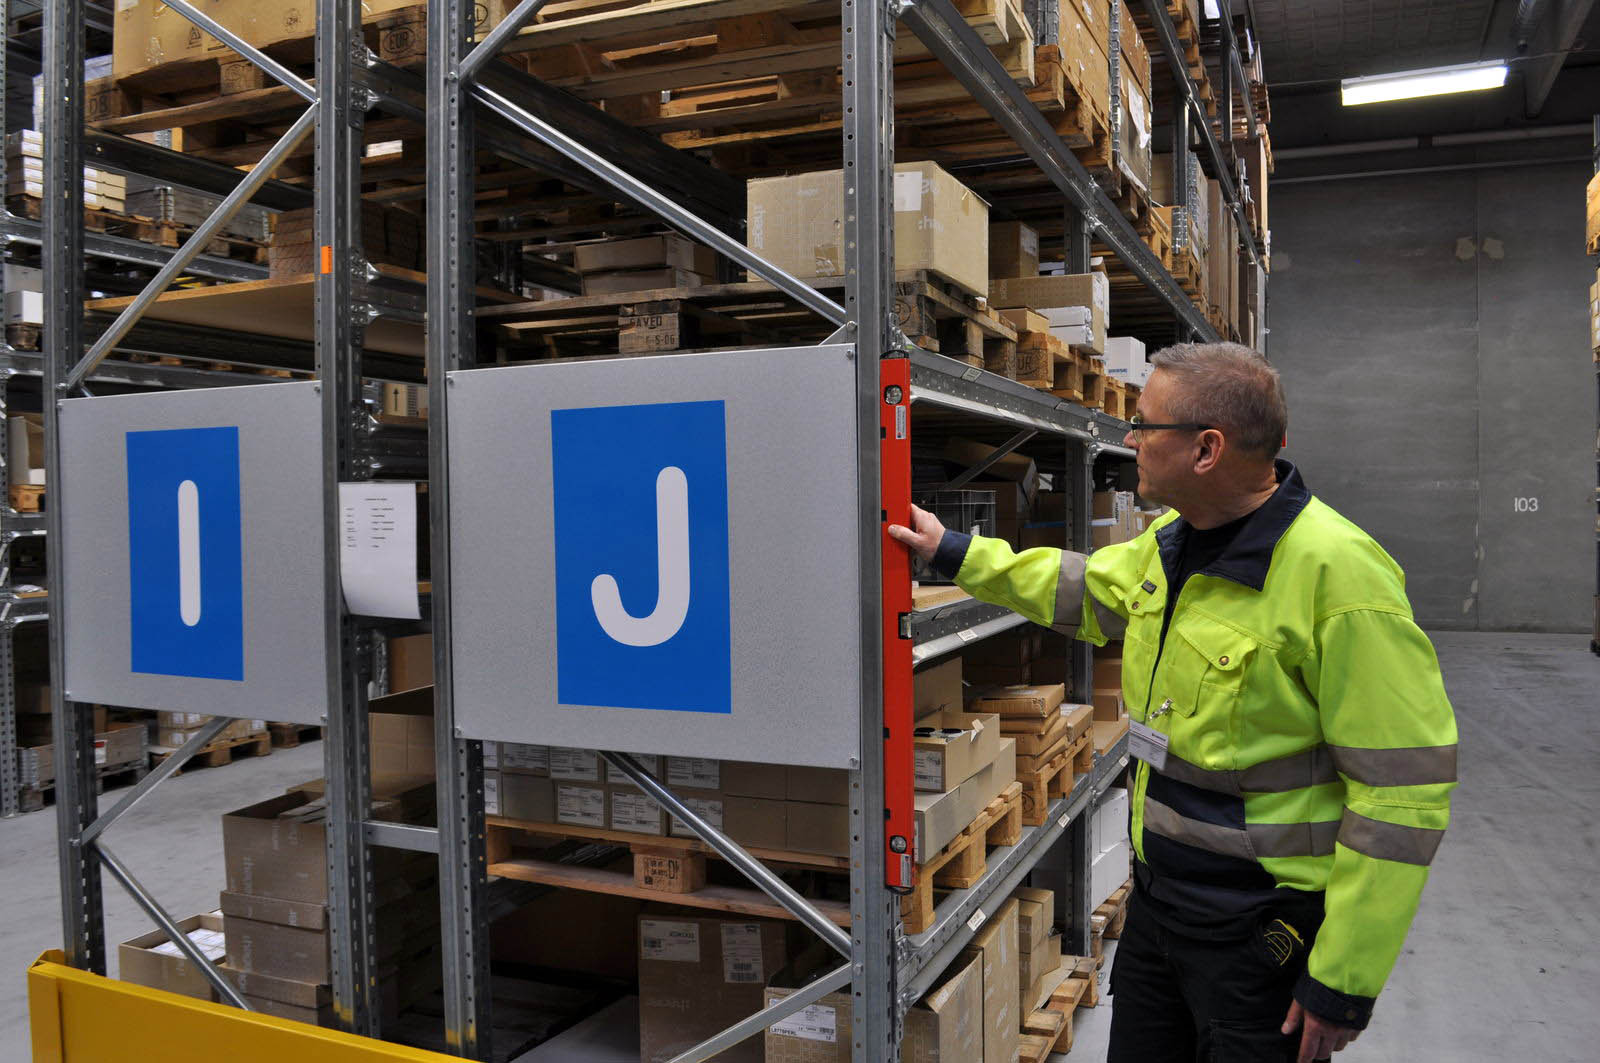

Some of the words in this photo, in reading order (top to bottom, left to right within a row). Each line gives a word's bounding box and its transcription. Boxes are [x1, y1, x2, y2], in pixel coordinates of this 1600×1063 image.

[178, 479, 201, 627] I
[591, 466, 690, 647] J
[1514, 497, 1538, 512] 103
